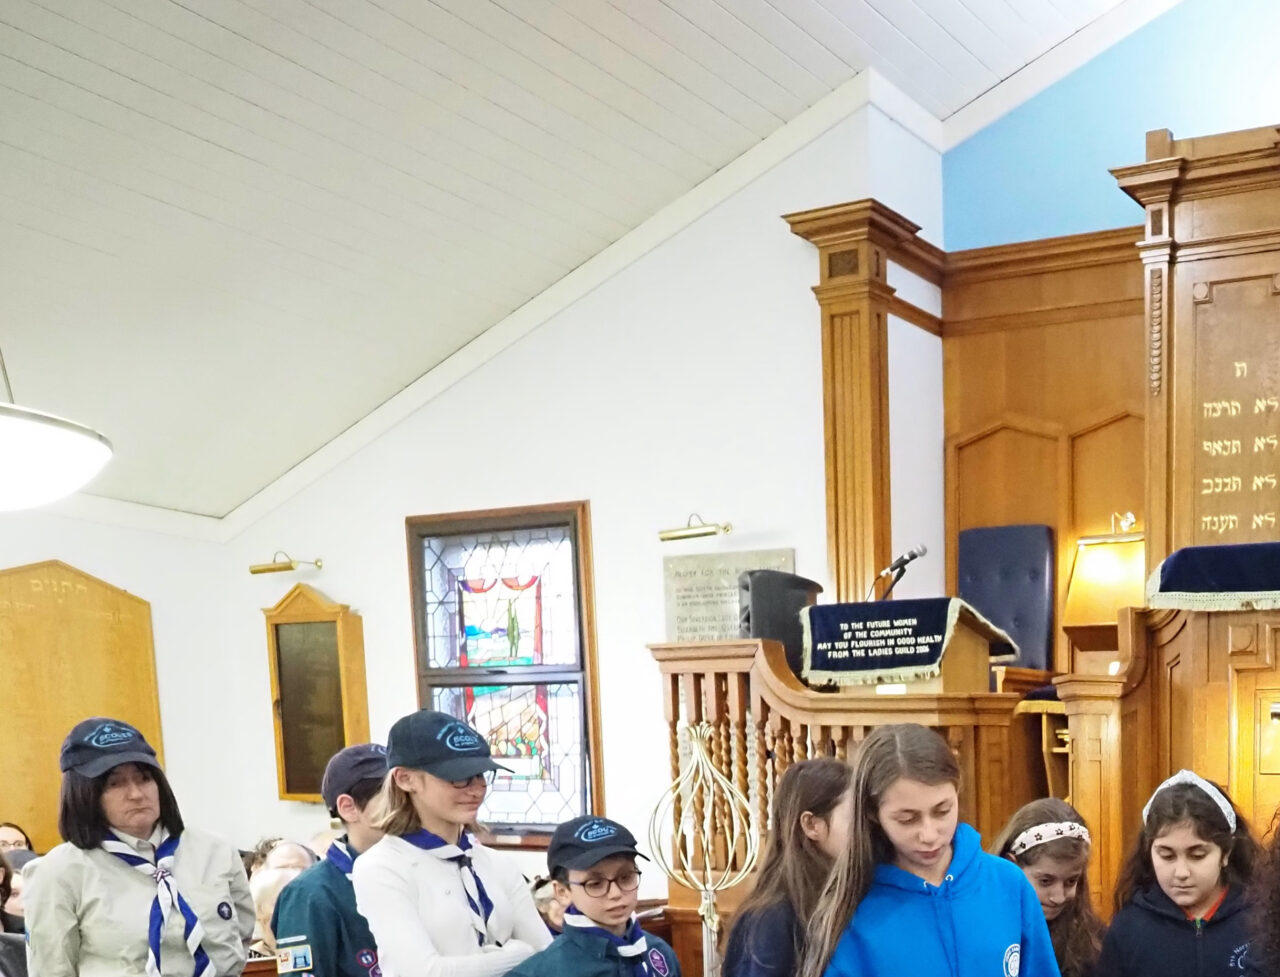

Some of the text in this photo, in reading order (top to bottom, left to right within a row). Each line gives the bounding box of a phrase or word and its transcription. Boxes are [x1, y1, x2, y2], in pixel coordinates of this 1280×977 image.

[1254, 397, 1279, 415] לא
[1254, 435, 1278, 453] לא
[1252, 474, 1277, 492] לא
[1201, 512, 1276, 534] לא תענה
[840, 618, 917, 631] TO THE FUTURE WOMEN
[843, 628, 913, 640] OF THE COMMUNITY
[817, 635, 942, 651] MAY YOU FLOURISH IN GOOD HEALTH
[828, 650, 849, 659] FROM
[852, 649, 865, 657] THE
[868, 647, 893, 657] LADIES
[895, 646, 914, 655] GUILD
